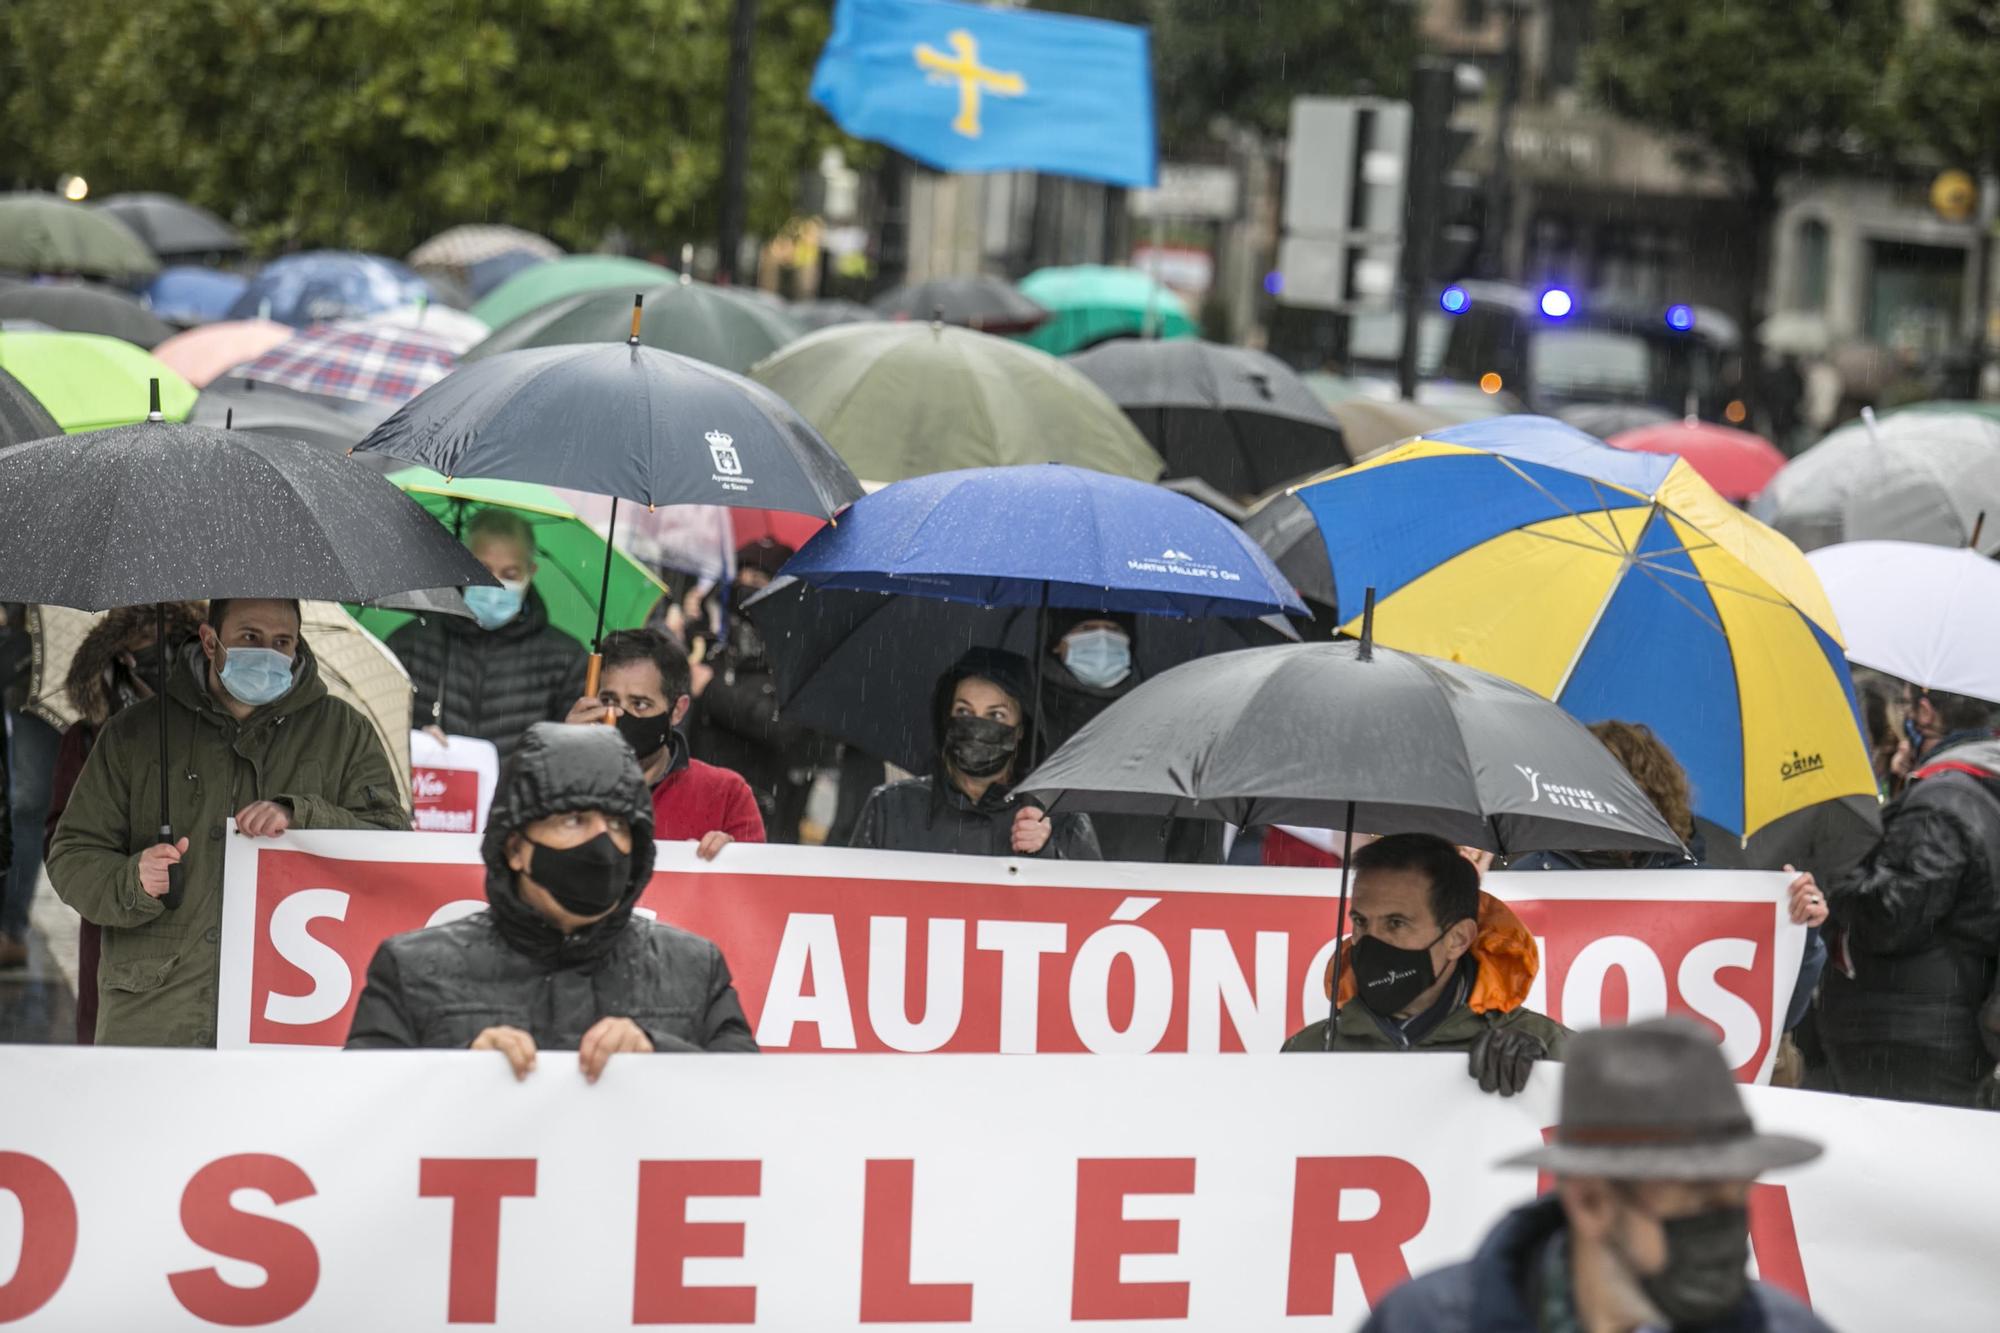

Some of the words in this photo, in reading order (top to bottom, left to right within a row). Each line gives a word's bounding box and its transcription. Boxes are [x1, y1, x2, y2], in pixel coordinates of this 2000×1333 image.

[711, 473, 754, 485] Ayuntamiento
[722, 482, 730, 490] de
[1542, 783, 1595, 799] HOTELES
[1548, 793, 1619, 814] SILKEN
[755, 897, 1762, 1071] AUTÓNOS
